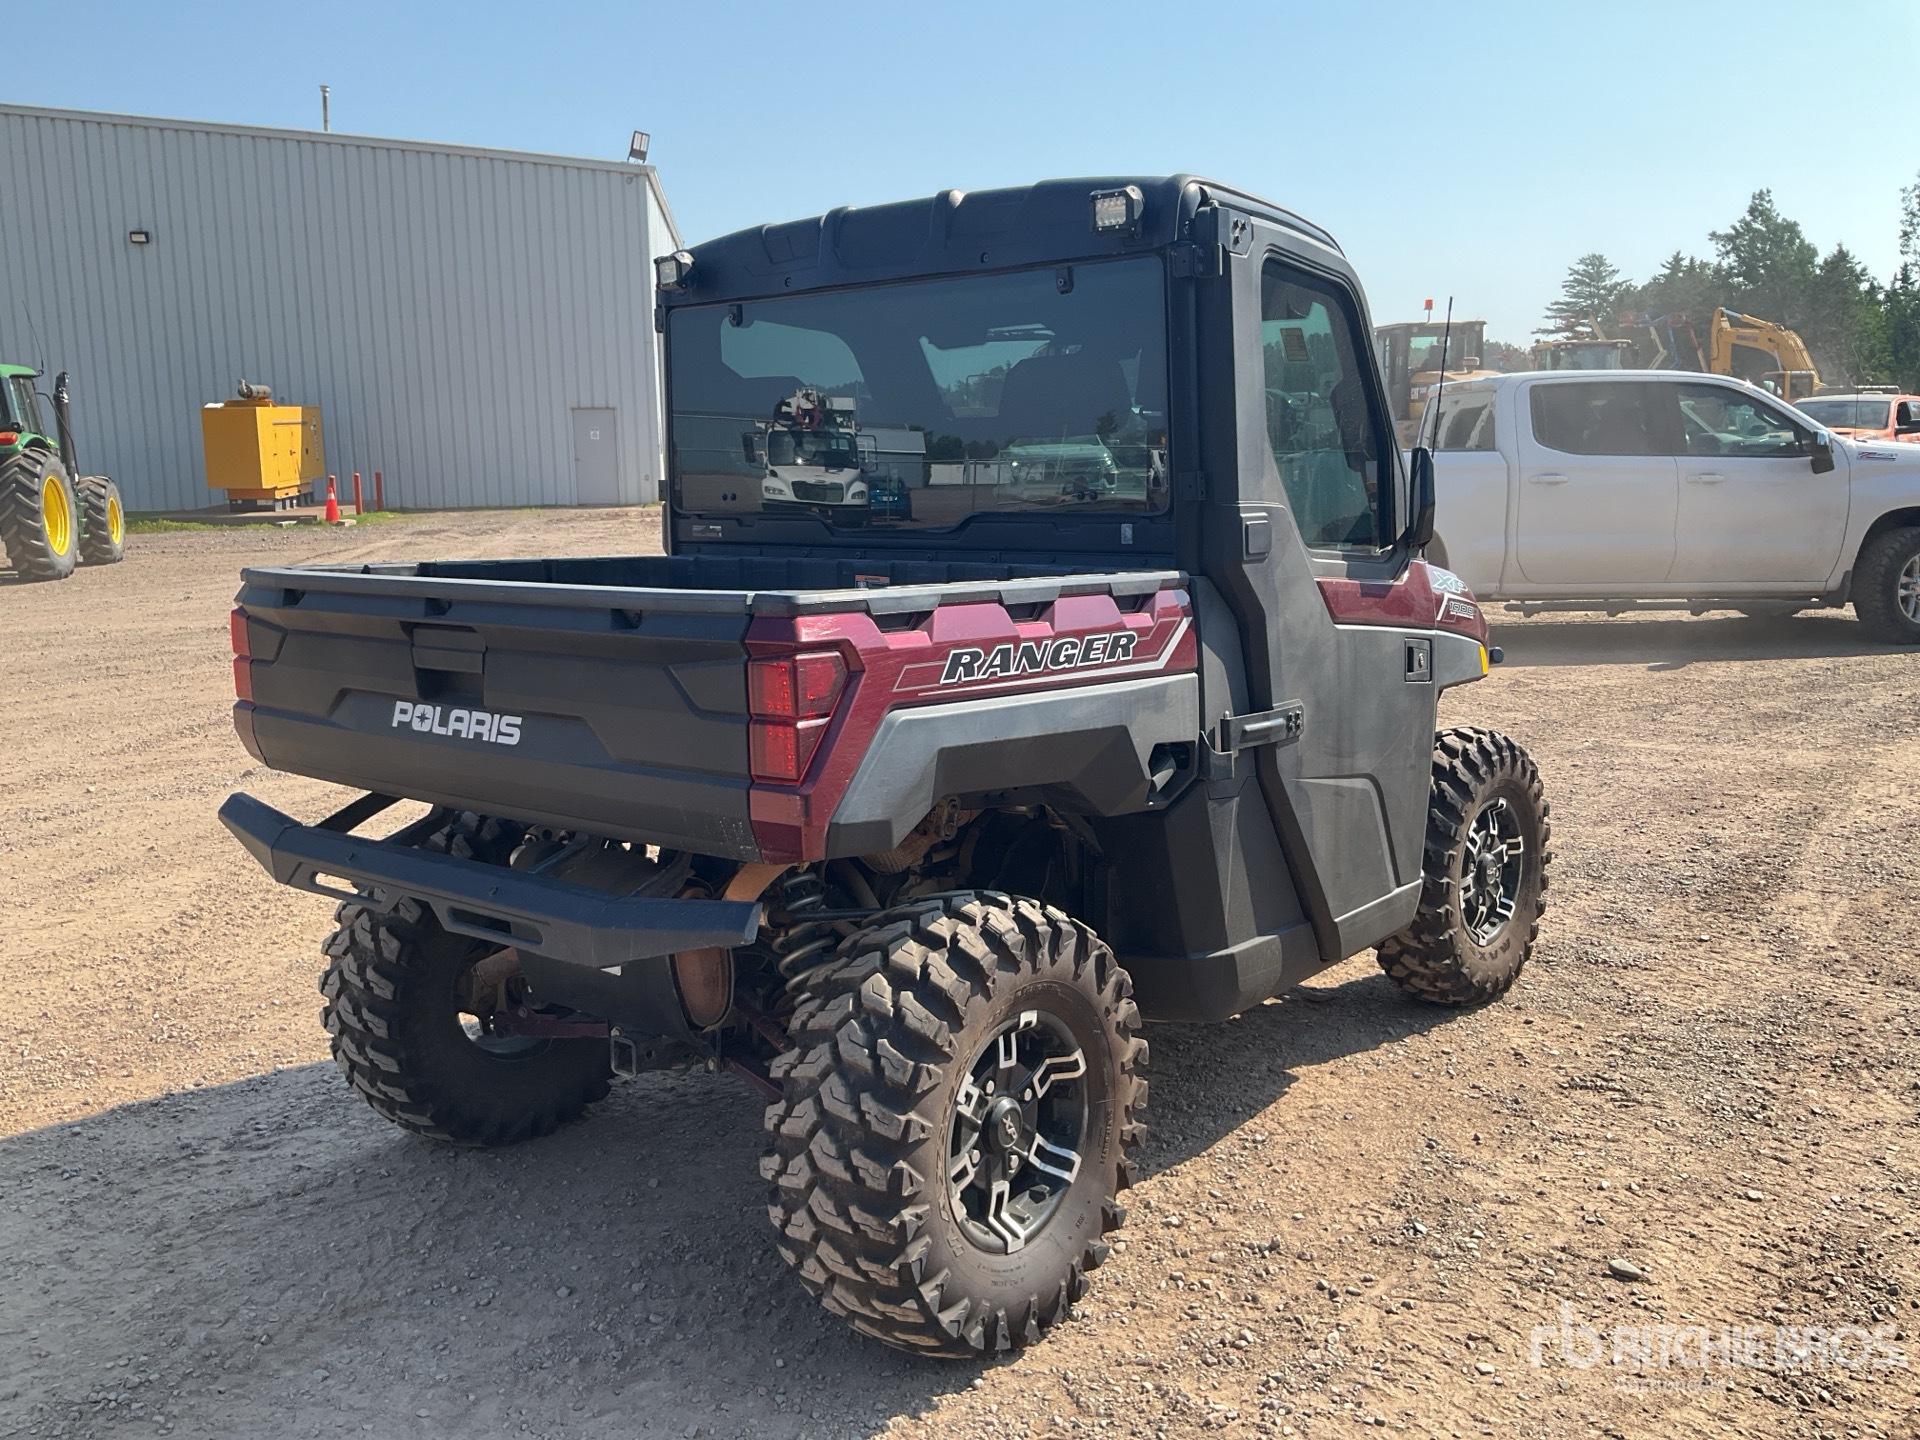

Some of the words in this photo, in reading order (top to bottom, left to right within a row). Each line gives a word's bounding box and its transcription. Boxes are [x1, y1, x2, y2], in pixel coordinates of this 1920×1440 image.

[1432, 570, 1469, 594] XP
[940, 631, 1138, 684] RANGER
[392, 700, 523, 746] POLARIS
[1002, 1114, 1018, 1140] XP
